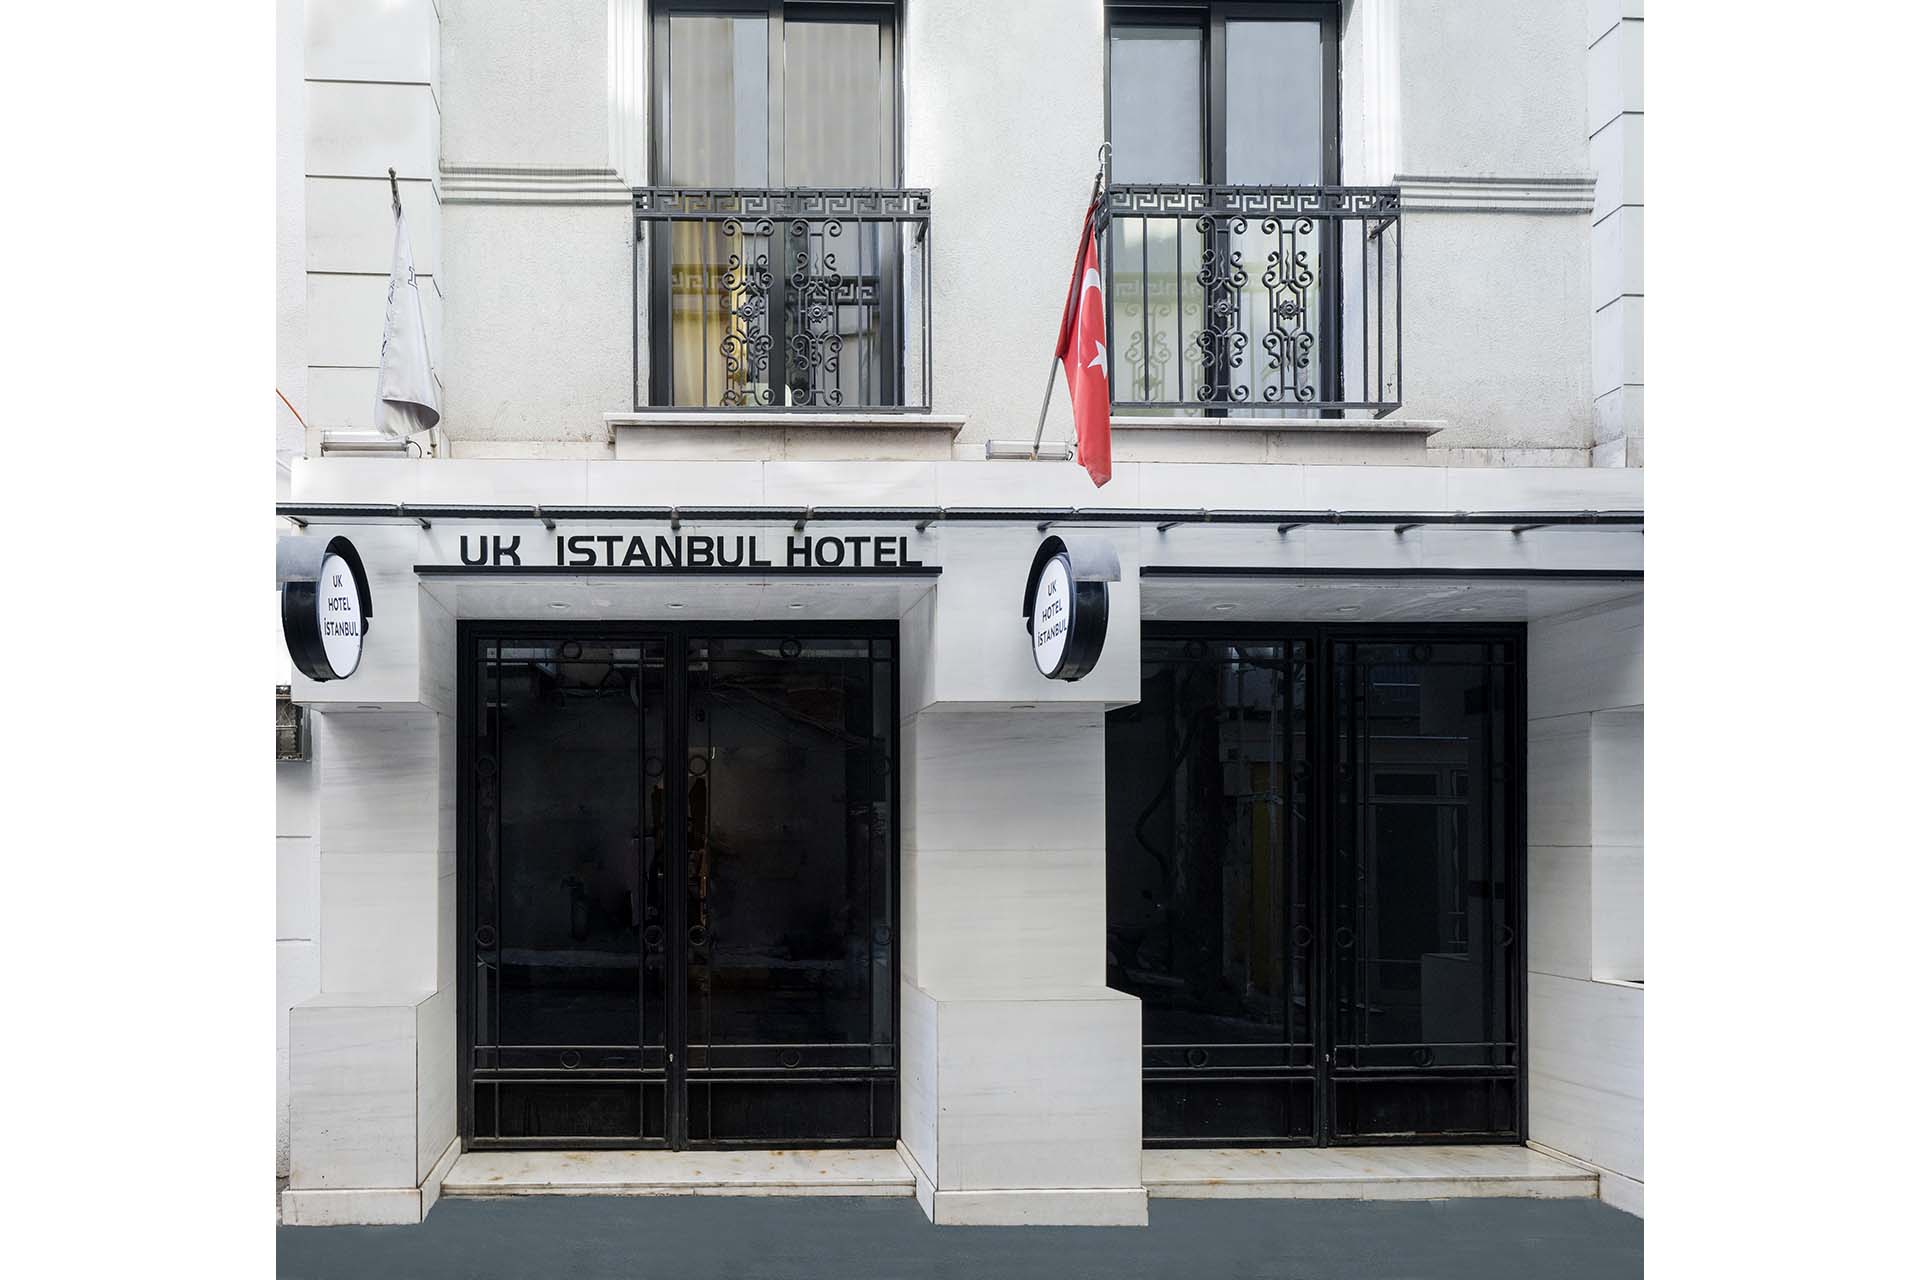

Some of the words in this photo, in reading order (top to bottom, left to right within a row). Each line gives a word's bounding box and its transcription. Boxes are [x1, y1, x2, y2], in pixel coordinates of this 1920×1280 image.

[459, 535, 521, 566] UK
[556, 535, 772, 567] ISTANBUL
[786, 536, 923, 567] HOTEL
[332, 575, 343, 588] UK
[1047, 579, 1057, 597] UK
[328, 597, 351, 611] HOTEL
[1042, 599, 1063, 623] HOTEL
[324, 617, 359, 636] İSTANBUL
